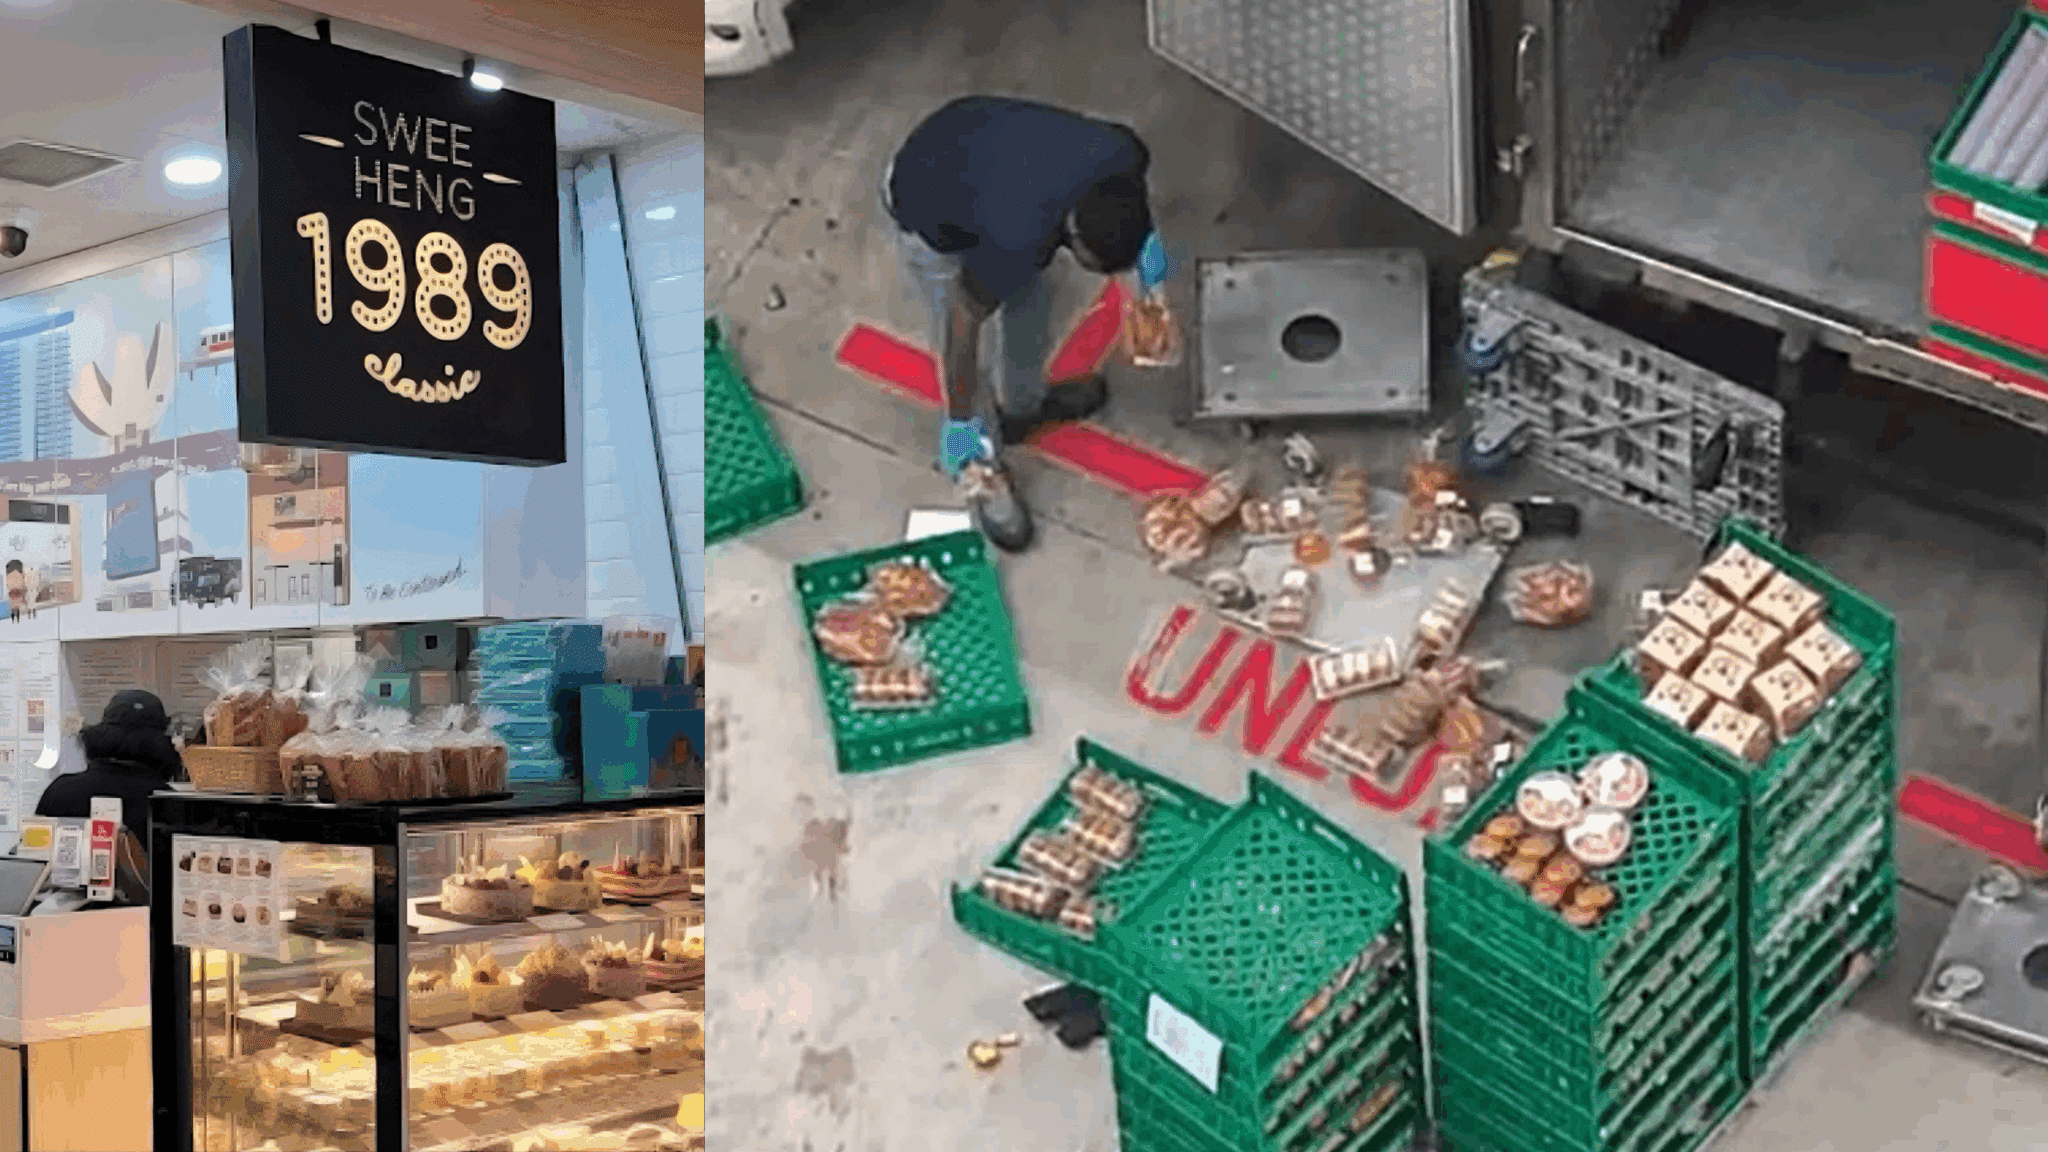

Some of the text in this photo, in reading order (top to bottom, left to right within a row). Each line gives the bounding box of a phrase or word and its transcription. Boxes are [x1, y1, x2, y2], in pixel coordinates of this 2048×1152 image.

[354, 101, 473, 167] SWEE
[354, 156, 476, 220] HENG
[297, 211, 532, 350] 1989
